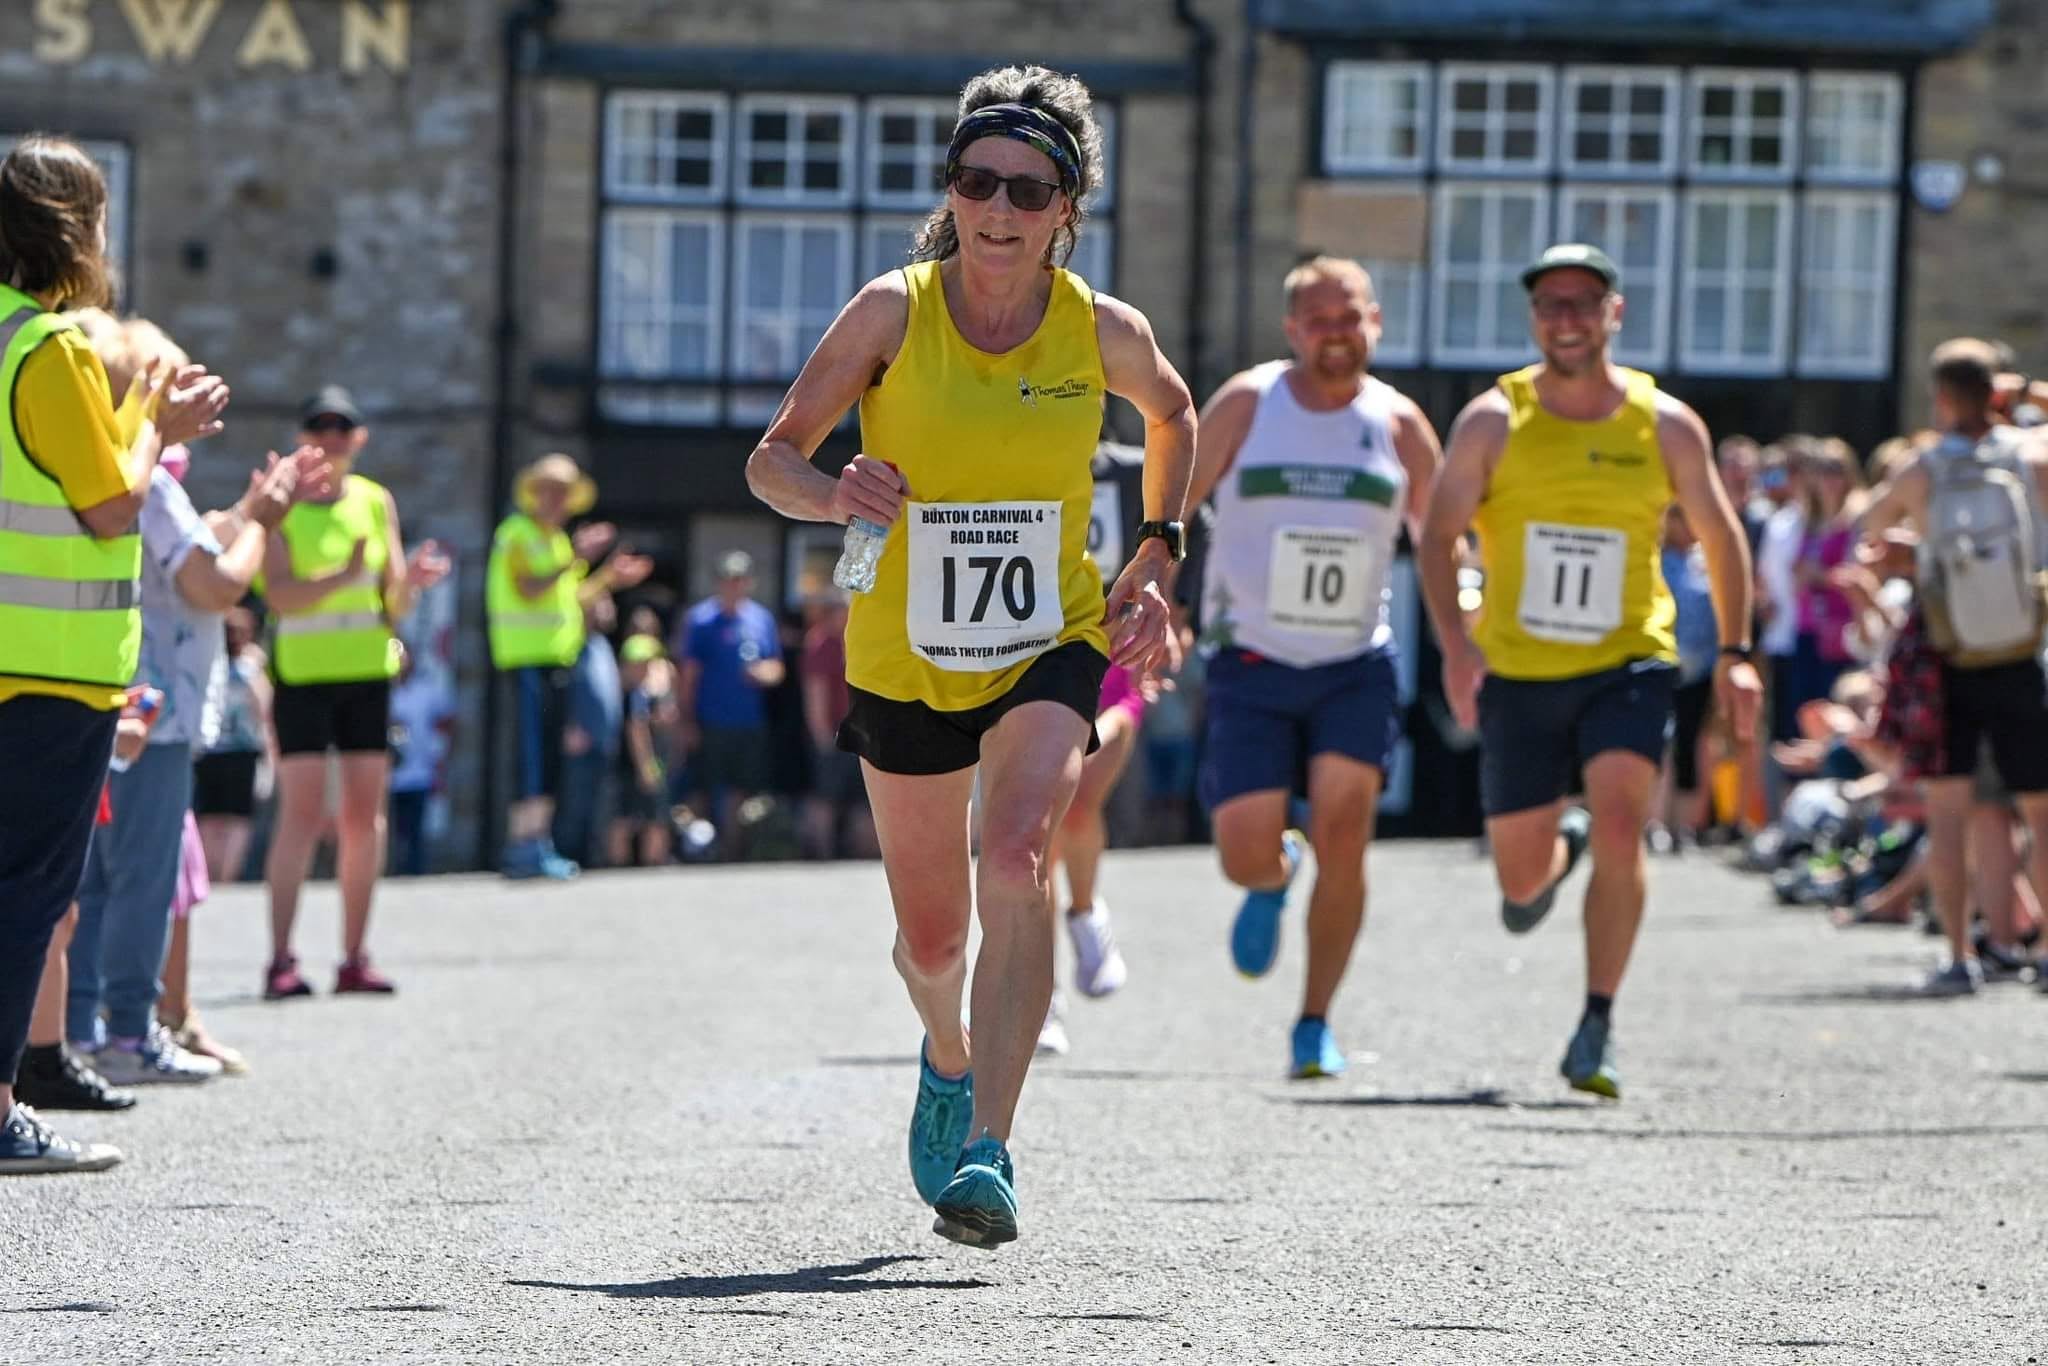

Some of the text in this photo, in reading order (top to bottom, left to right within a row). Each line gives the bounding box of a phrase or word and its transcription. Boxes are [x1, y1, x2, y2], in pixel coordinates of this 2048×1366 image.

[32, 0, 412, 72] SWAN
[922, 509, 1044, 524] BUXTON CARNIVAL 4
[950, 530, 1019, 544] ROAD RACE
[942, 555, 1036, 623] 170
[1301, 562, 1345, 605] 10
[1552, 561, 1591, 608] 11
[958, 645, 995, 658] THEYER
